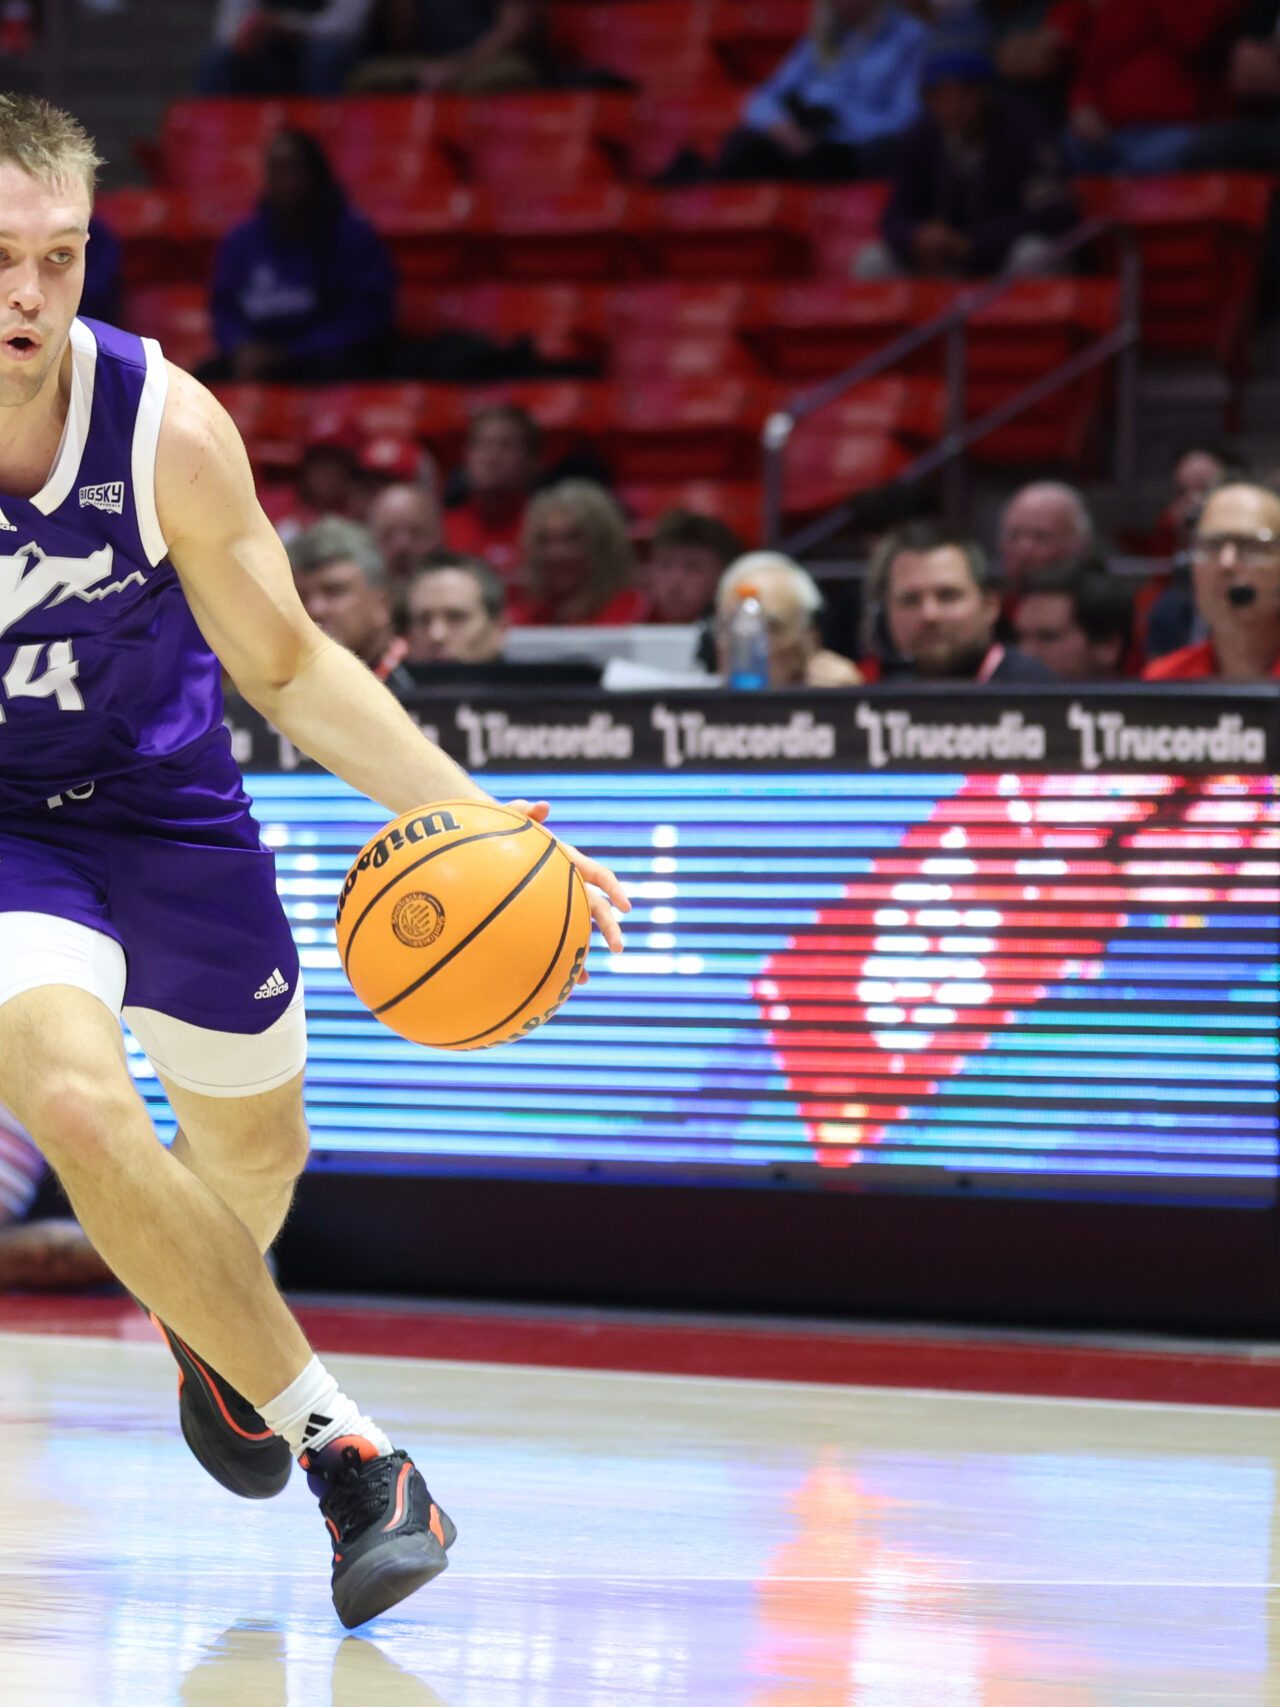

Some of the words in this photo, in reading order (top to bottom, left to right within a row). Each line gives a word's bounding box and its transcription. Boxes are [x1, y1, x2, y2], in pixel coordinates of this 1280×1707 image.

[487, 708, 633, 759] Trucordia
[679, 711, 835, 760] Trucordia
[884, 711, 1046, 760] Trucordia
[1096, 711, 1267, 763] Trucordia
[254, 982, 289, 1000] adidas
